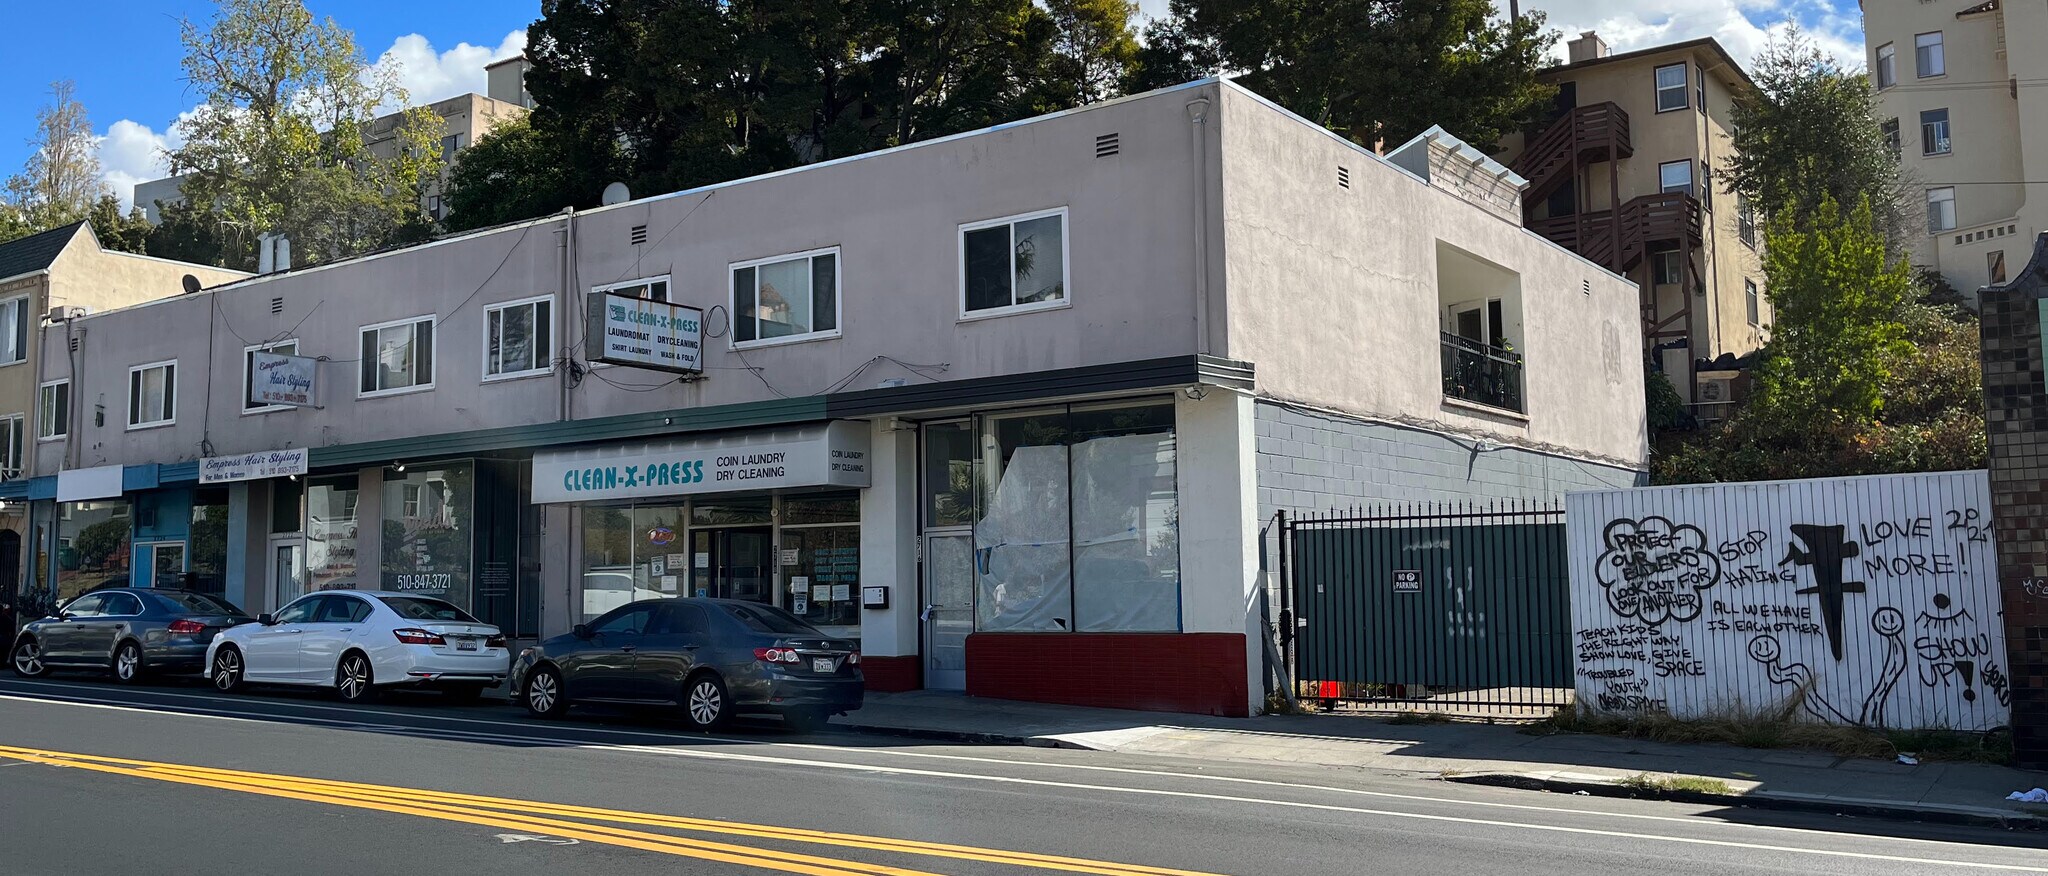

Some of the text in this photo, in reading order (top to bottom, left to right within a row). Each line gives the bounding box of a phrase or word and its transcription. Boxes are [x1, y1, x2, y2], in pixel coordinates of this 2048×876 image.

[628, 310, 698, 333] CLEAN-X-PRESS
[608, 327, 698, 349] LAUNDROMAT DRYCLEANING
[612, 343, 627, 352] SHIRT
[629, 346, 652, 355] LAUNDRY
[660, 351, 675, 359] WASH
[259, 359, 289, 371] Empress
[270, 371, 311, 392] Hair Styling
[206, 451, 301, 471] Empress Hair Styling
[831, 450, 864, 459] COIN LAUNDRY
[564, 452, 786, 492] CLEAN-X-PRESS COIN LAUNDRY
[716, 466, 785, 481] DRY CLEANING
[842, 463, 864, 472] CLEANING
[1614, 530, 1682, 551] PROTECT
[1861, 518, 1931, 547] LOVE
[1719, 531, 1767, 561] STOP
[397, 574, 451, 589] 510-847-3721
[1612, 568, 1711, 600] LOOK OUT FOR
[1723, 565, 1796, 589] HATING
[1618, 591, 1699, 613] ONE ANOTHER
[1713, 600, 1810, 619] ALL WE HAVE
[1577, 624, 1661, 640] TEACH KIDS
[1707, 620, 1824, 638] IS EACH OTHER
[1577, 635, 1680, 651] THE RIGHT WAY
[1579, 650, 1614, 662] SHOW
[1652, 649, 1692, 661] GIVE
[1655, 661, 1705, 677] SPACE
